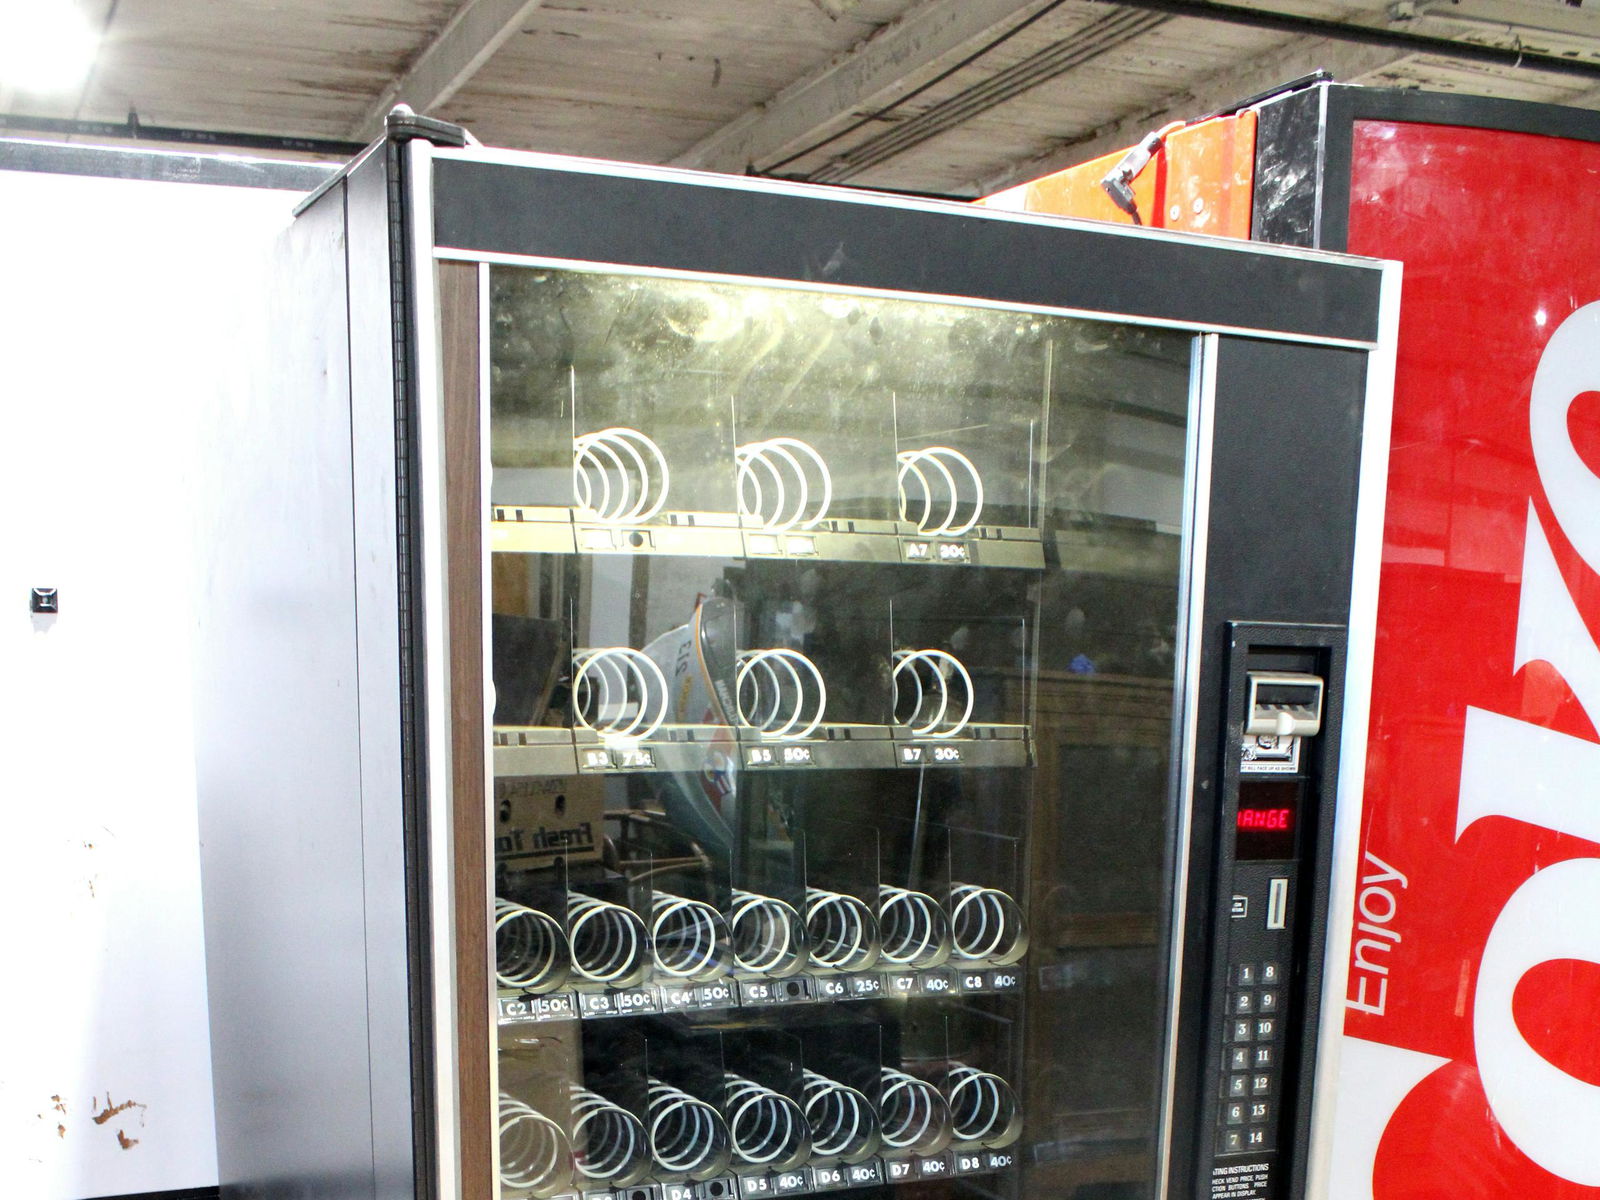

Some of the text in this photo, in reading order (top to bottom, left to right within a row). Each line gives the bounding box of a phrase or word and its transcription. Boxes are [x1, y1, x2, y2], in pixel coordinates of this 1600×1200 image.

[908, 543, 928, 556] A7
[751, 747, 772, 762] B5
[903, 747, 960, 761] B7 30¢
[1345, 850, 1409, 1017] Enjoy
[1243, 968, 1249, 979] 1
[1266, 966, 1274, 978] 8
[825, 979, 880, 995] C6 25¢
[896, 977, 949, 991] C7 40¢
[965, 975, 1016, 988] C8 40¢
[671, 987, 729, 1005] C4 50¢
[749, 985, 768, 998] C5
[589, 992, 651, 1010] C3 50¢
[1240, 996, 1249, 1007] 2
[1263, 994, 1272, 1006] 9
[507, 999, 569, 1016] C2 50¢
[1238, 1024, 1246, 1035] 3
[1258, 1022, 1272, 1034] 10
[1236, 1051, 1244, 1063] 4
[1258, 1050, 1269, 1061] 11
[1234, 1080, 1242, 1090] 5
[1254, 1077, 1268, 1089] 12
[1232, 1107, 1240, 1118] 6
[1252, 1104, 1266, 1116] 13
[1230, 1134, 1238, 1145] 7
[1250, 1132, 1263, 1144] 14
[891, 1160, 945, 1176] D7 40¢
[961, 1154, 1012, 1170] D8 40¢
[1228, 1163, 1270, 1174] INSTRUCTIONS
[821, 1167, 876, 1183] D6 40¢
[1255, 1173, 1269, 1181] PUSH
[747, 1175, 804, 1192] D5 40¢
[671, 1188, 692, 1200] D4
